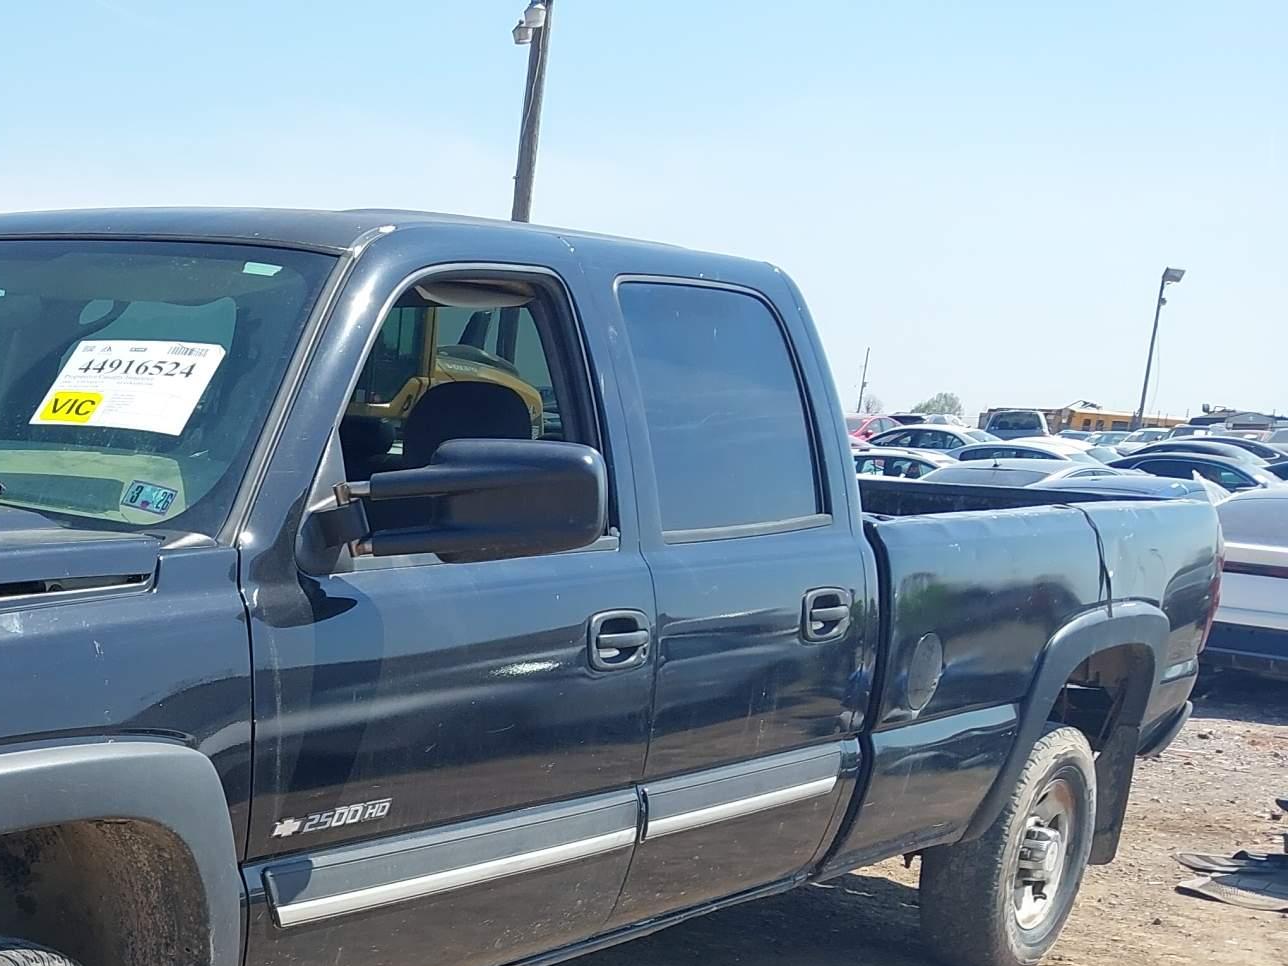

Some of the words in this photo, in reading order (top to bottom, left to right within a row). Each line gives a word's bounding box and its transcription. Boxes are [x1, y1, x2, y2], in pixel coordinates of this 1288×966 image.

[78, 358, 196, 378] 44916524
[50, 397, 96, 416] VIC
[129, 485, 144, 504] 3
[155, 491, 173, 511] 26
[303, 803, 363, 832] 2500
[364, 802, 391, 819] HD
